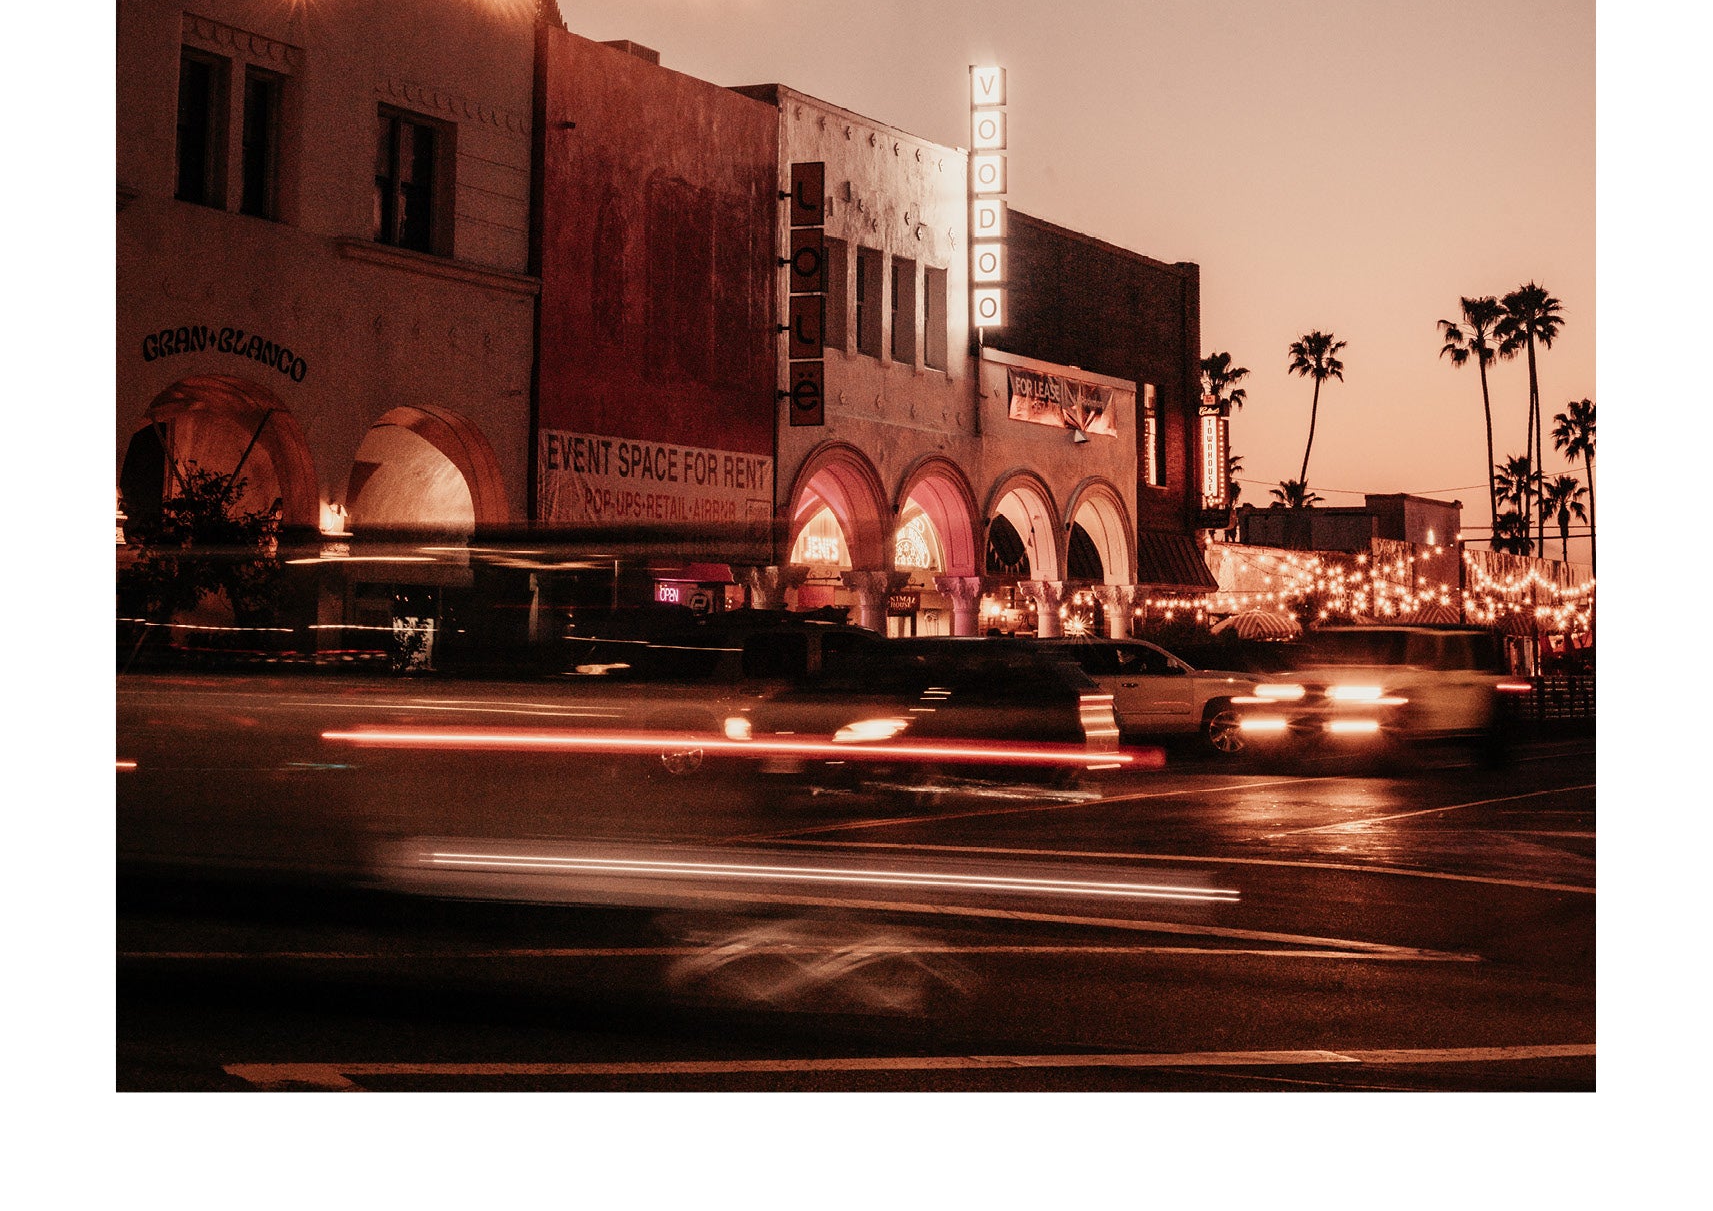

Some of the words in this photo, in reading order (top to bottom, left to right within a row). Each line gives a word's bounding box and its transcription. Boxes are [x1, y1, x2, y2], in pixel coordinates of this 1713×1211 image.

[976, 74, 998, 320] VOODOO
[142, 325, 208, 362] GRAN
[217, 327, 307, 383] BLANCO
[1015, 376, 1033, 396] FOR
[1034, 379, 1061, 403] LEASE
[547, 433, 613, 476] EVENT
[618, 442, 678, 483] SPACE
[684, 451, 718, 486] FOR
[724, 455, 768, 491] RENT
[659, 587, 679, 602] OPEN
